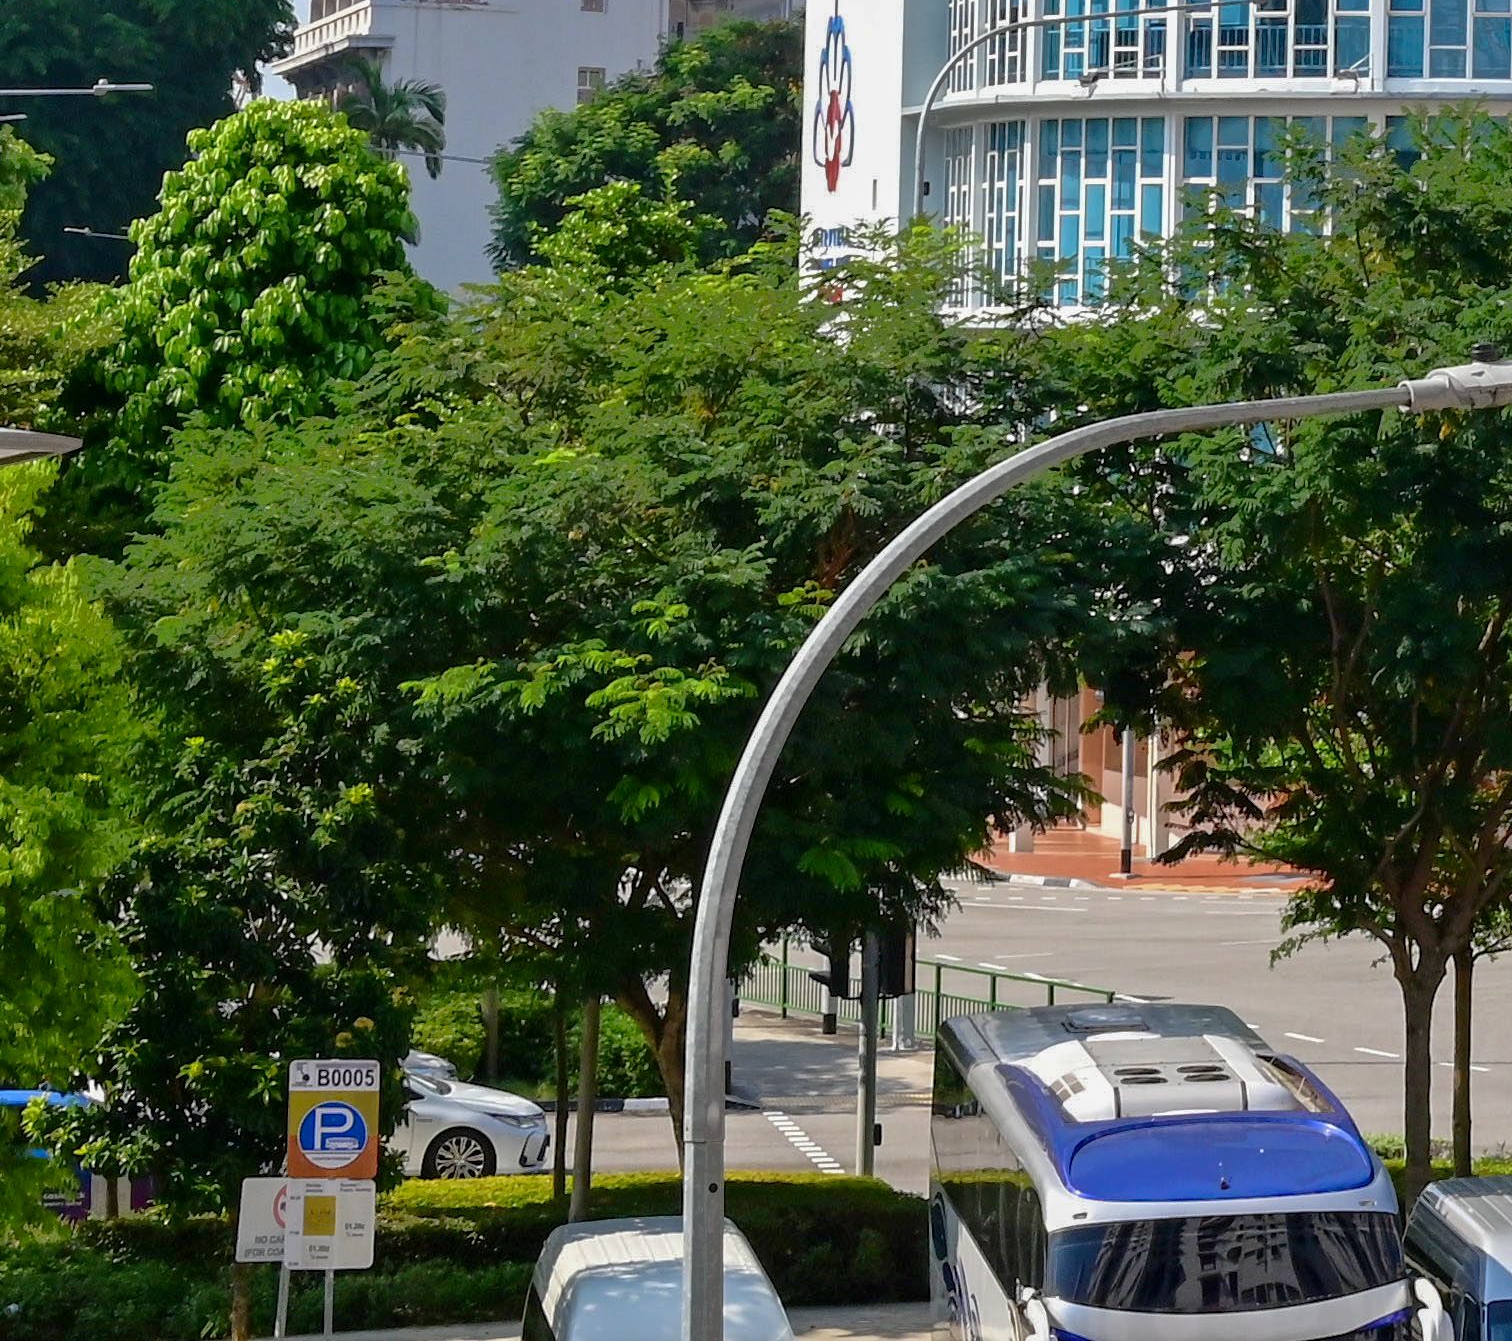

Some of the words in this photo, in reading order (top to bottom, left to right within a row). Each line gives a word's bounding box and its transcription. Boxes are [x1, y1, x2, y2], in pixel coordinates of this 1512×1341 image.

[318, 1069, 375, 1087] B0005
[314, 1107, 354, 1150] P
[267, 1248, 285, 1256] COA
